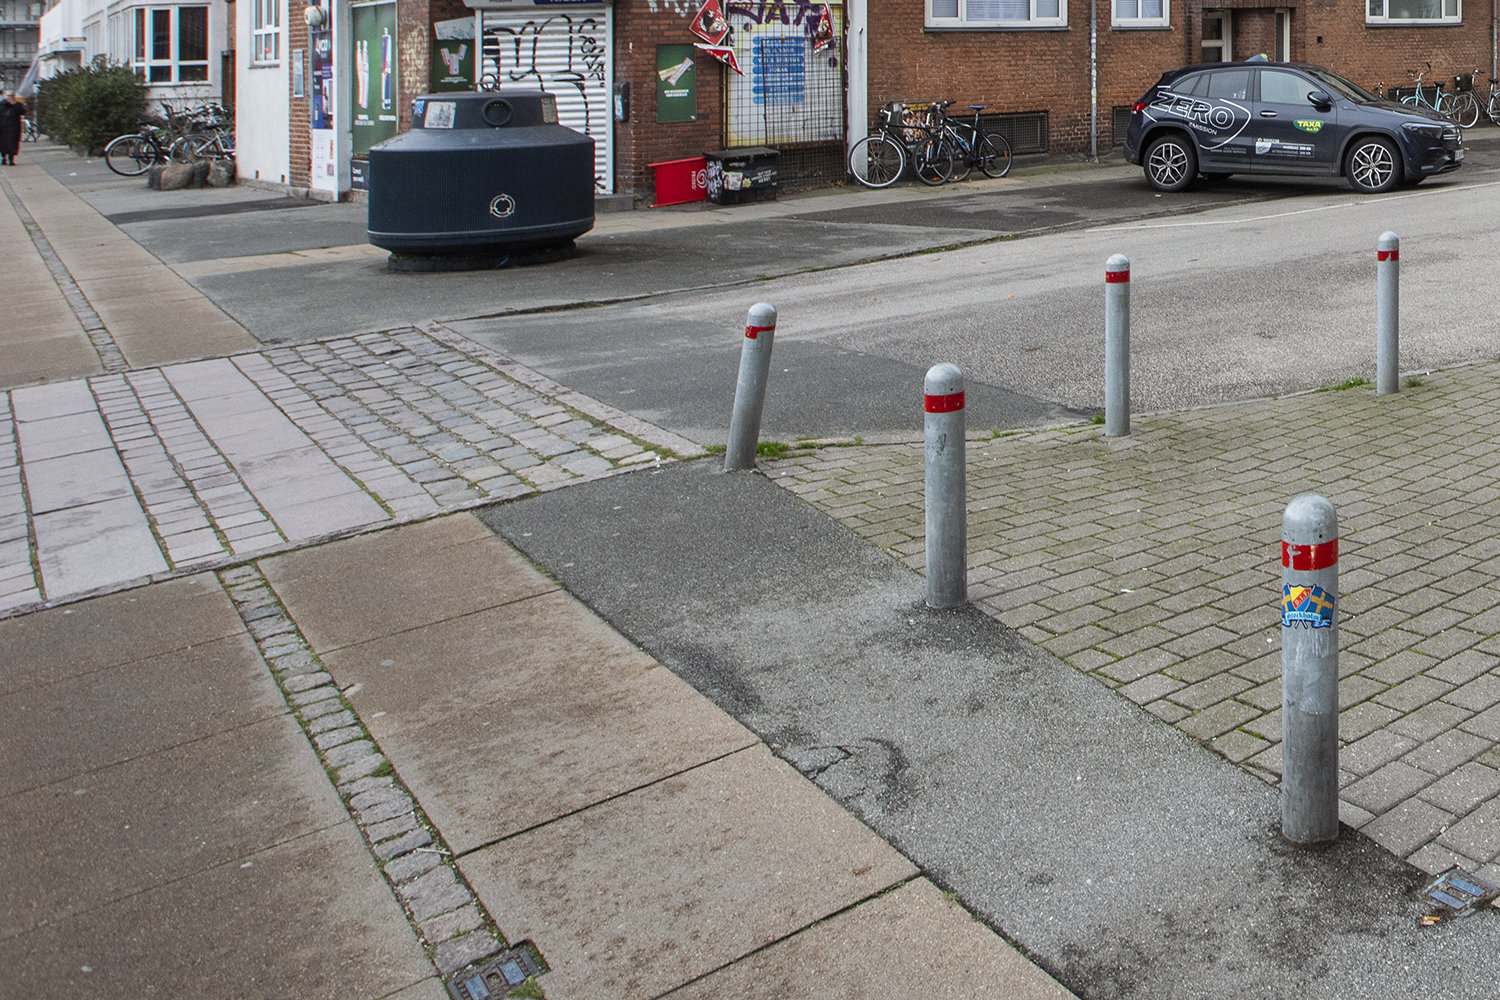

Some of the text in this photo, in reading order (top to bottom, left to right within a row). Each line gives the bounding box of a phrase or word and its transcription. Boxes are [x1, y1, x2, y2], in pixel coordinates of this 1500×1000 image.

[1149, 91, 1235, 130] ZERO
[1189, 122, 1218, 135] EMISSION
[1297, 120, 1321, 128] TAXA
